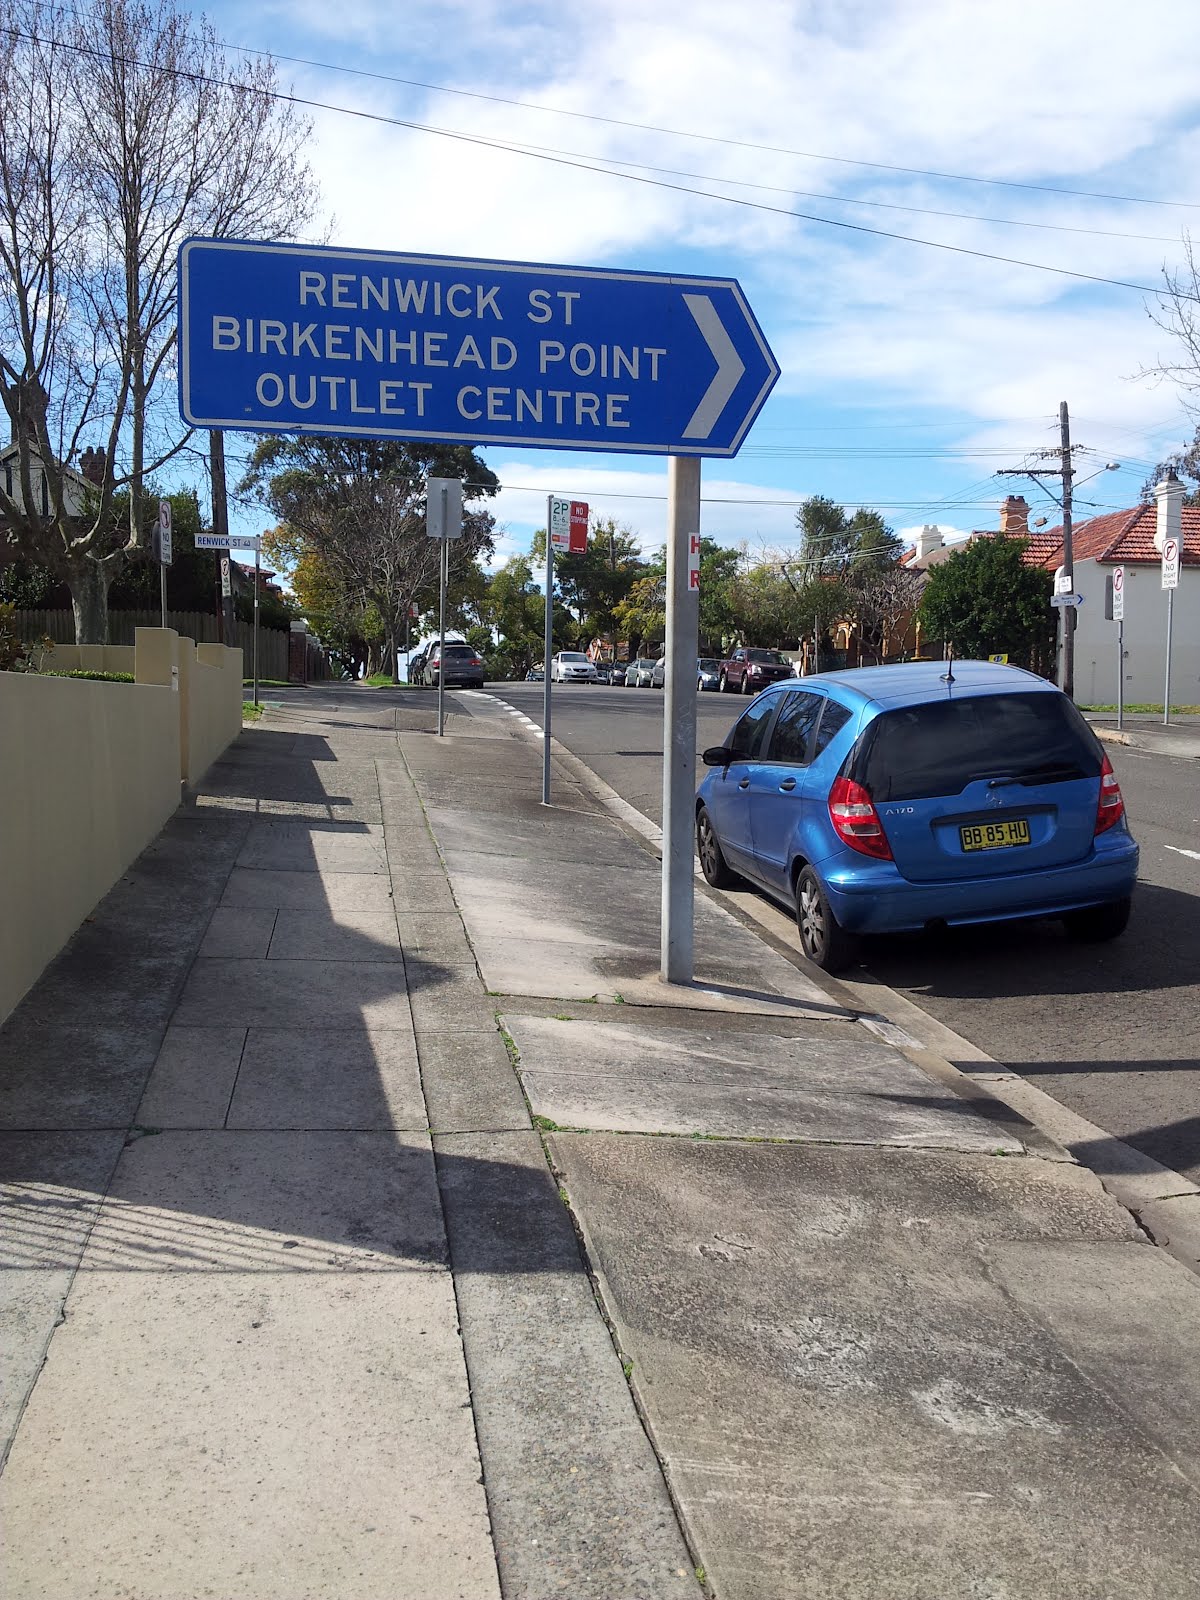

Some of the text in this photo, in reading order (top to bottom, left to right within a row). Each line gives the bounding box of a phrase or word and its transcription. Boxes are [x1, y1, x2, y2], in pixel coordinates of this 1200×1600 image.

[299, 271, 581, 325] RENWICK ST
[212, 315, 667, 381] BIRKENHEAD POINT
[255, 372, 630, 428] OUTLET CENTRE
[553, 502, 568, 515] 2P
[575, 506, 584, 516] NO
[197, 536, 241, 547] RENWICK ST
[1165, 563, 1175, 572] NO
